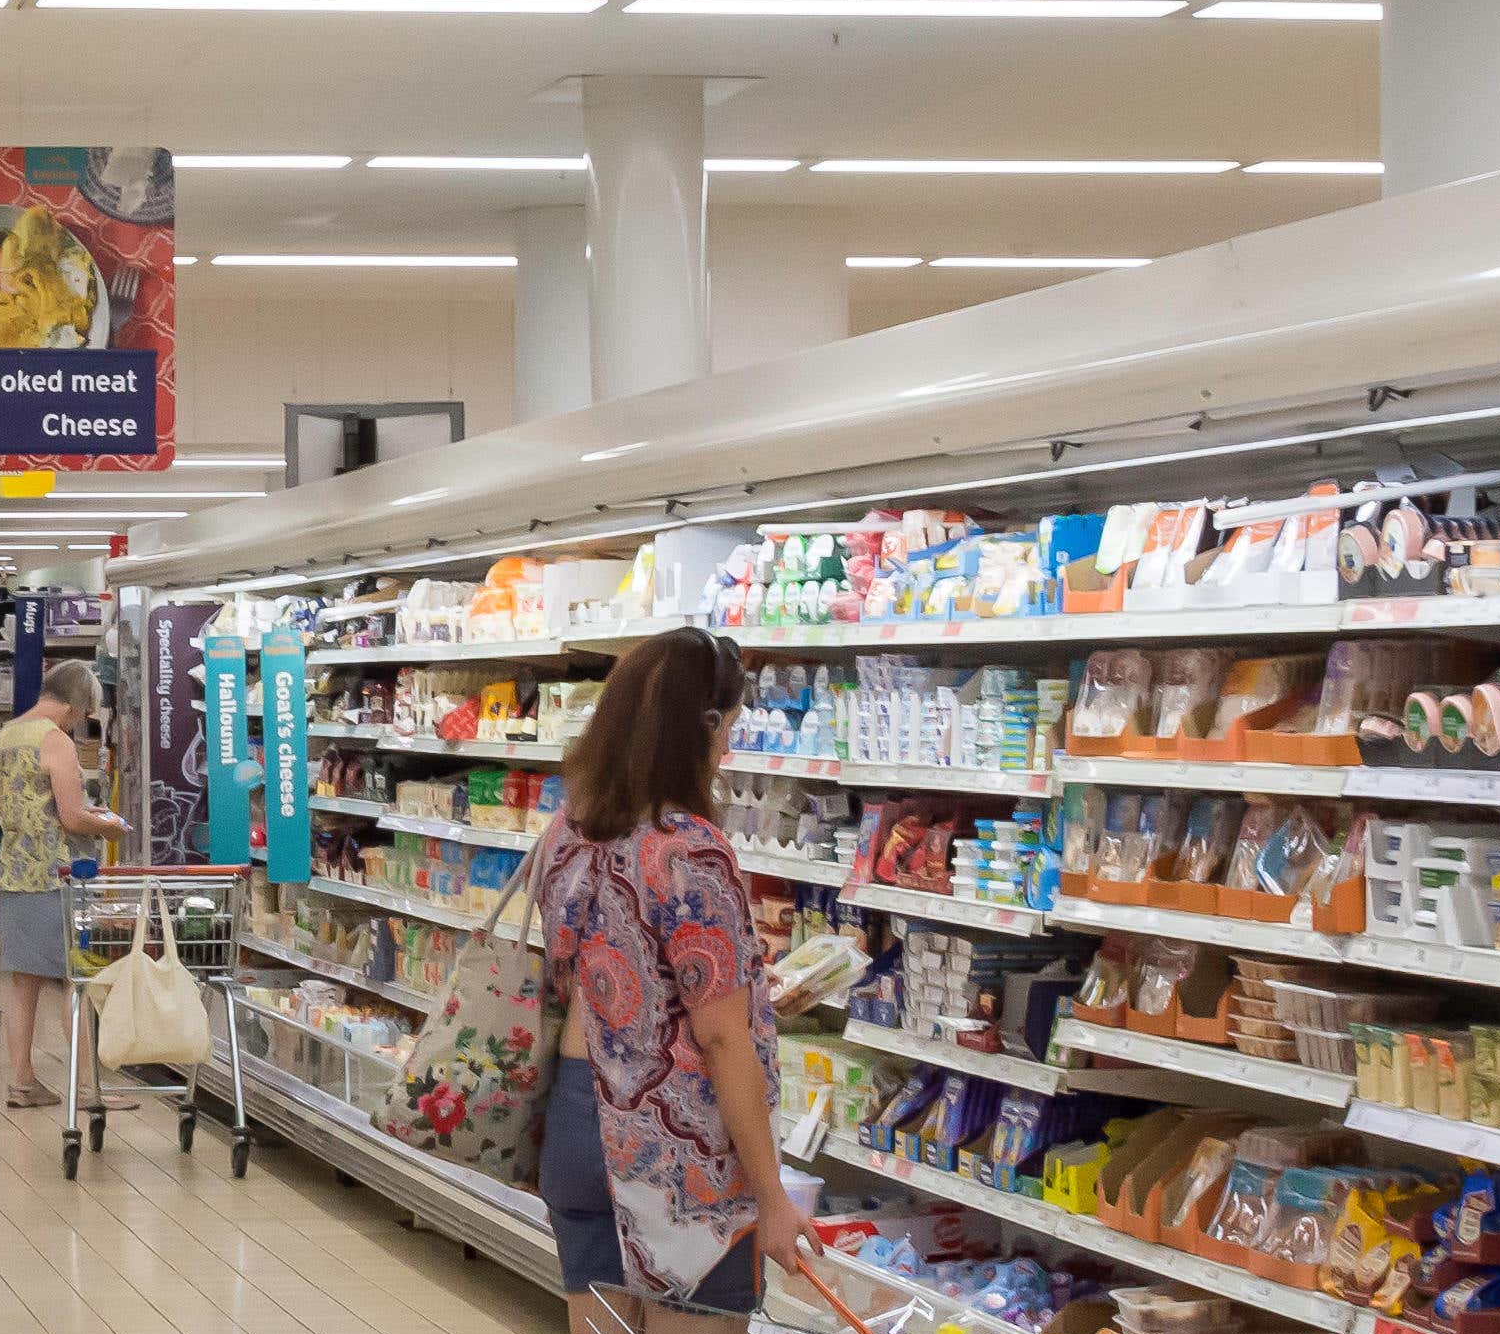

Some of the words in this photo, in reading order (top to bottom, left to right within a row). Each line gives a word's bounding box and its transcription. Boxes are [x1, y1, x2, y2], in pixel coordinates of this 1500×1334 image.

[72, 369, 138, 394] meat
[42, 413, 138, 437] Cheese
[24, 600, 40, 635] Mugs
[154, 619, 175, 697] Speciality
[158, 697, 175, 750] cheese
[217, 672, 238, 766] Halloumi
[274, 670, 299, 739] Goat's
[277, 742, 299, 818] cheese
